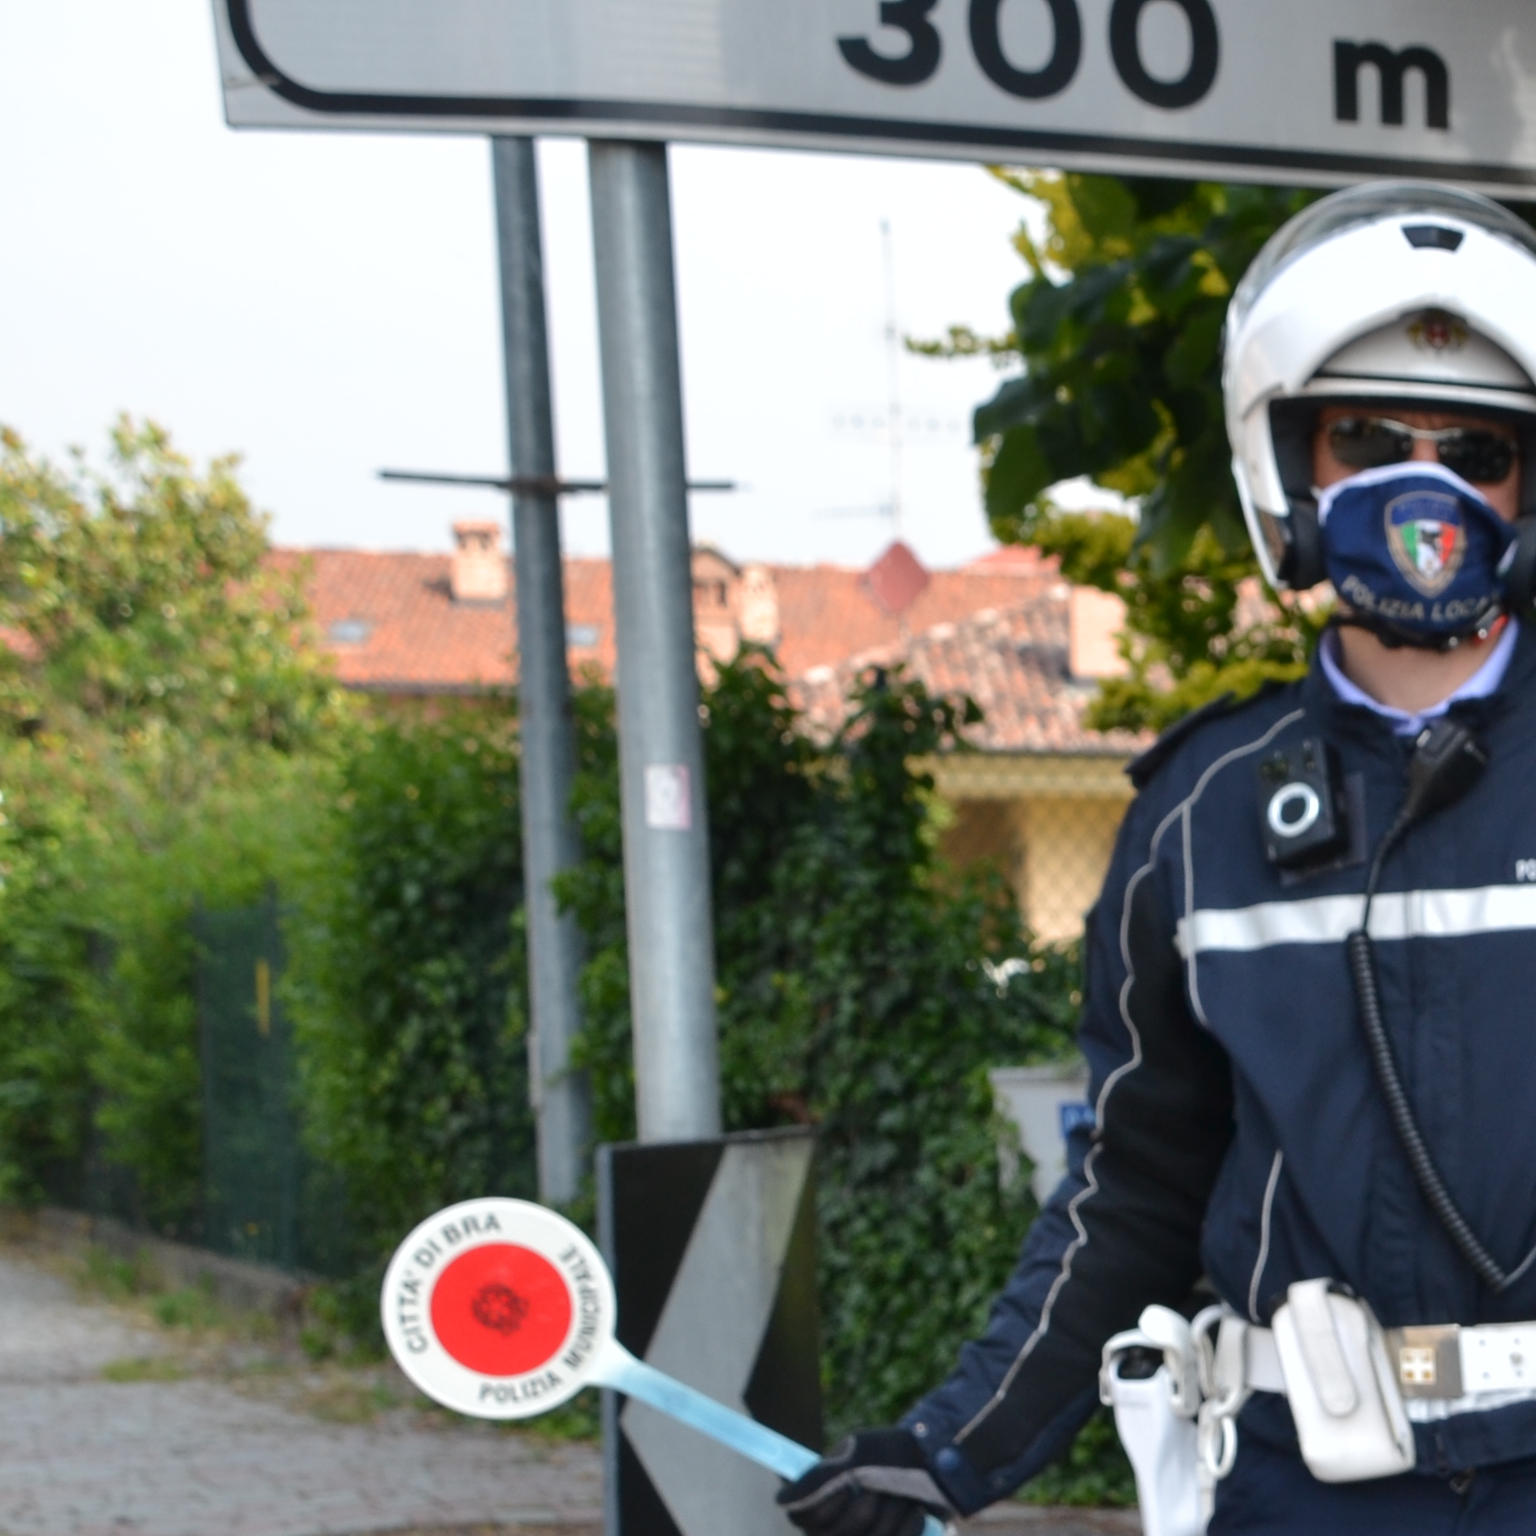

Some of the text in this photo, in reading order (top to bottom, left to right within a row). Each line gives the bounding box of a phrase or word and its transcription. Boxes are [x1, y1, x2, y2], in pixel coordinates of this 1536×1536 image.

[836, 0, 1450, 130] 300 m
[1341, 574, 1424, 621] POLIZIA
[413, 1240, 443, 1269] DI
[441, 1212, 502, 1247] BRA
[478, 1243, 600, 1404] POLIZIA MUNICIPALE
